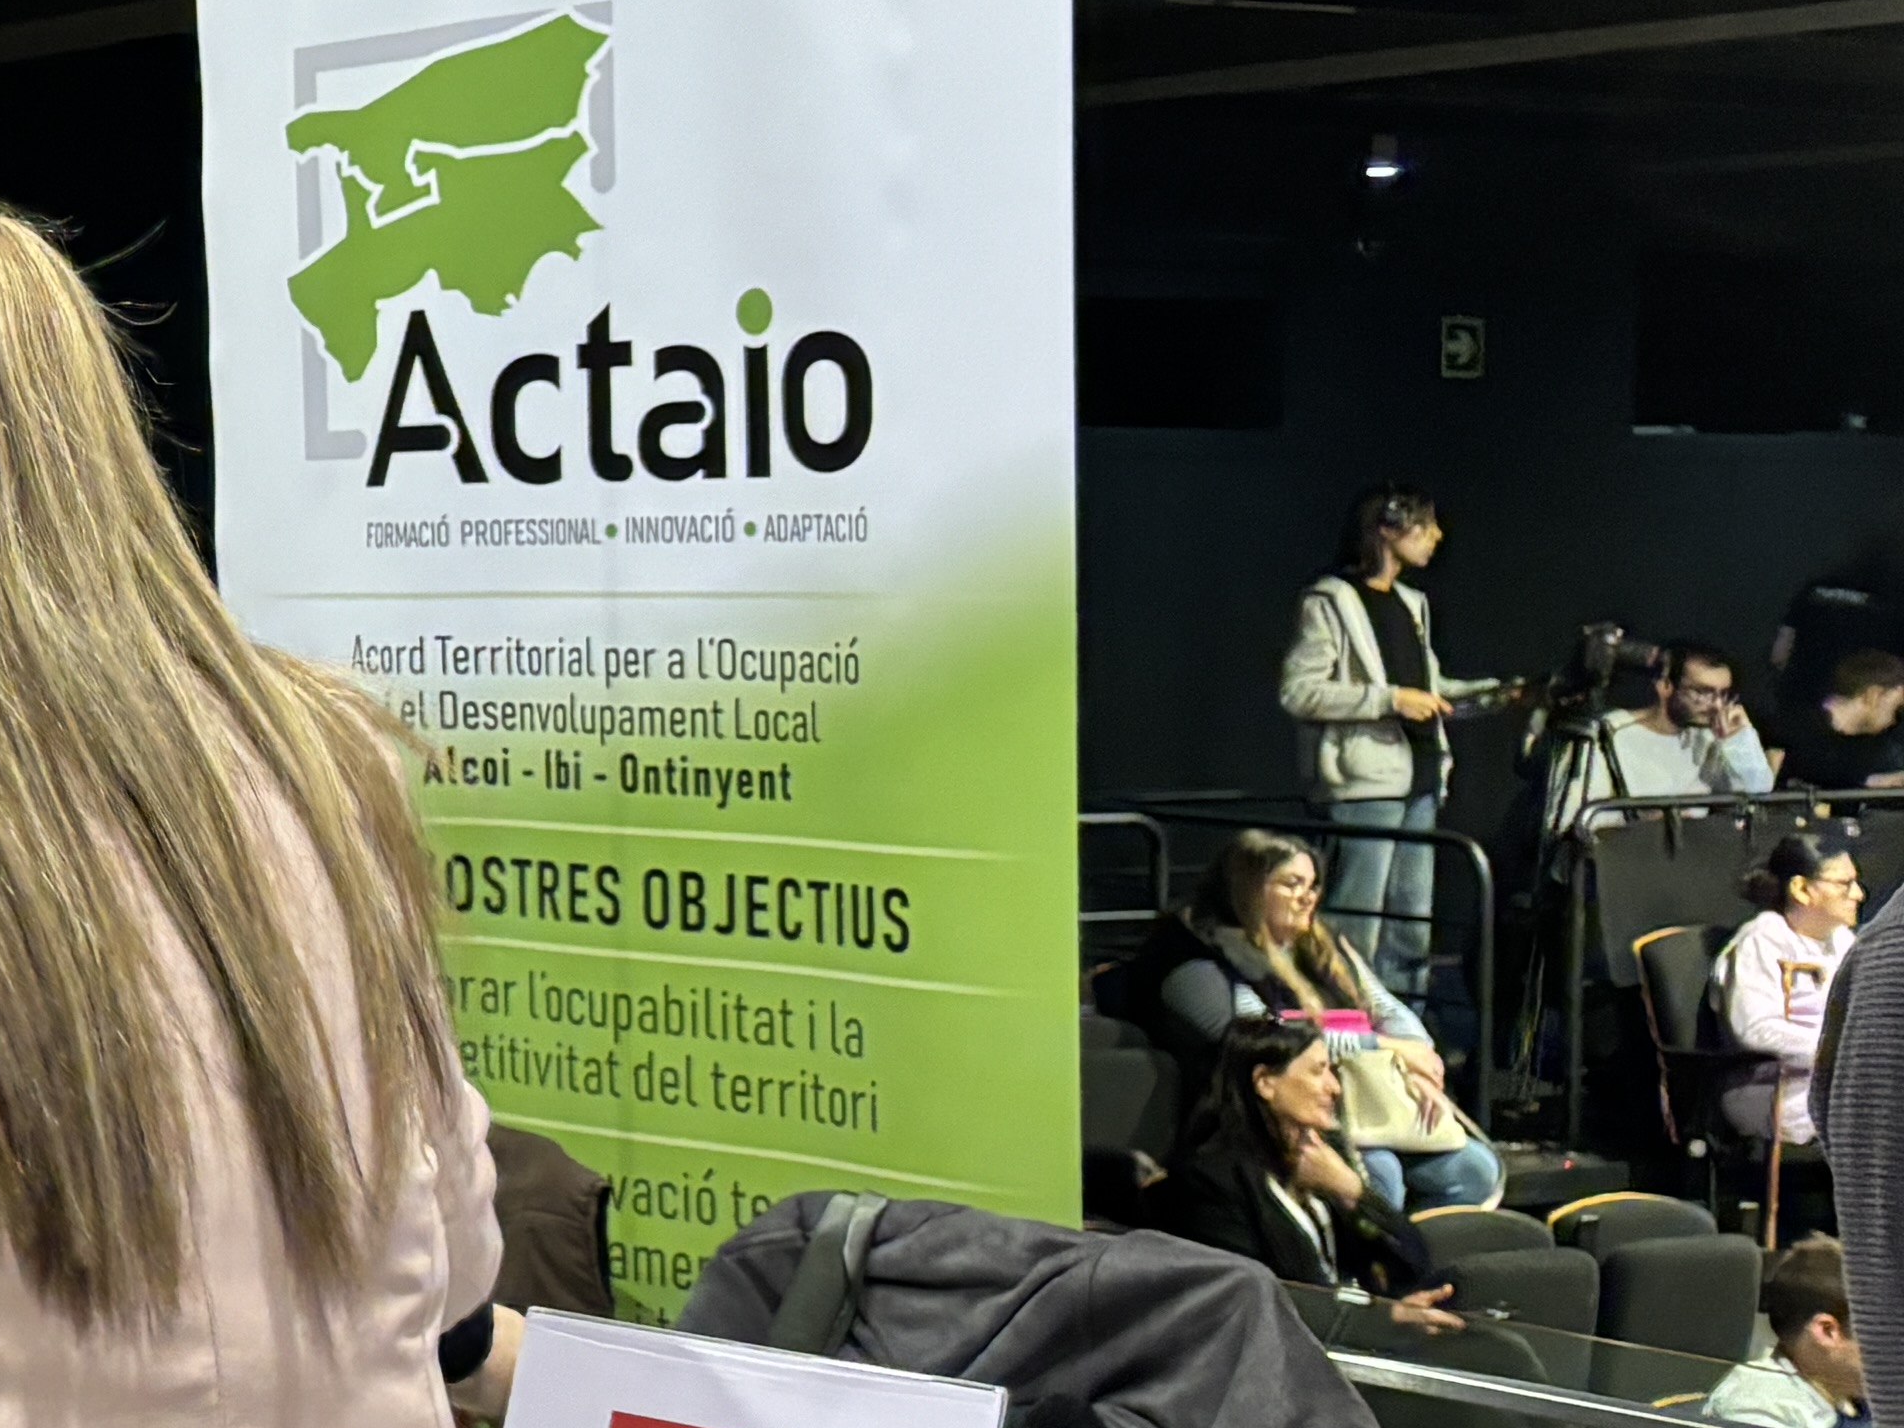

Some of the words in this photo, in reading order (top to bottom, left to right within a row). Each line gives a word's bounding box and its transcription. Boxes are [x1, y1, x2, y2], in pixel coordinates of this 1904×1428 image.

[365, 287, 874, 488] Actaio
[365, 514, 450, 549] FORMACIÓ
[460, 516, 602, 548] PROFESSIONAL
[624, 508, 736, 545] INNOVACIÓ
[763, 506, 868, 545] ADAPTACIÓ
[352, 634, 426, 675] Acord
[434, 635, 595, 678] Territorial
[604, 645, 657, 688] per
[667, 647, 686, 676] a
[696, 635, 861, 694] l'Ocupació
[438, 690, 725, 746] Desenvolupament
[733, 697, 822, 744] Local
[423, 746, 512, 788] Alcoi
[544, 750, 582, 791] Ibi
[619, 752, 793, 809] Ontinyent
[642, 868, 912, 954] OBJECTIUS
[527, 969, 796, 1050] l'ocupabilitat
[808, 999, 816, 1052] i
[830, 1000, 865, 1060] la
[633, 1050, 699, 1109] del
[711, 1061, 880, 1134] territori
